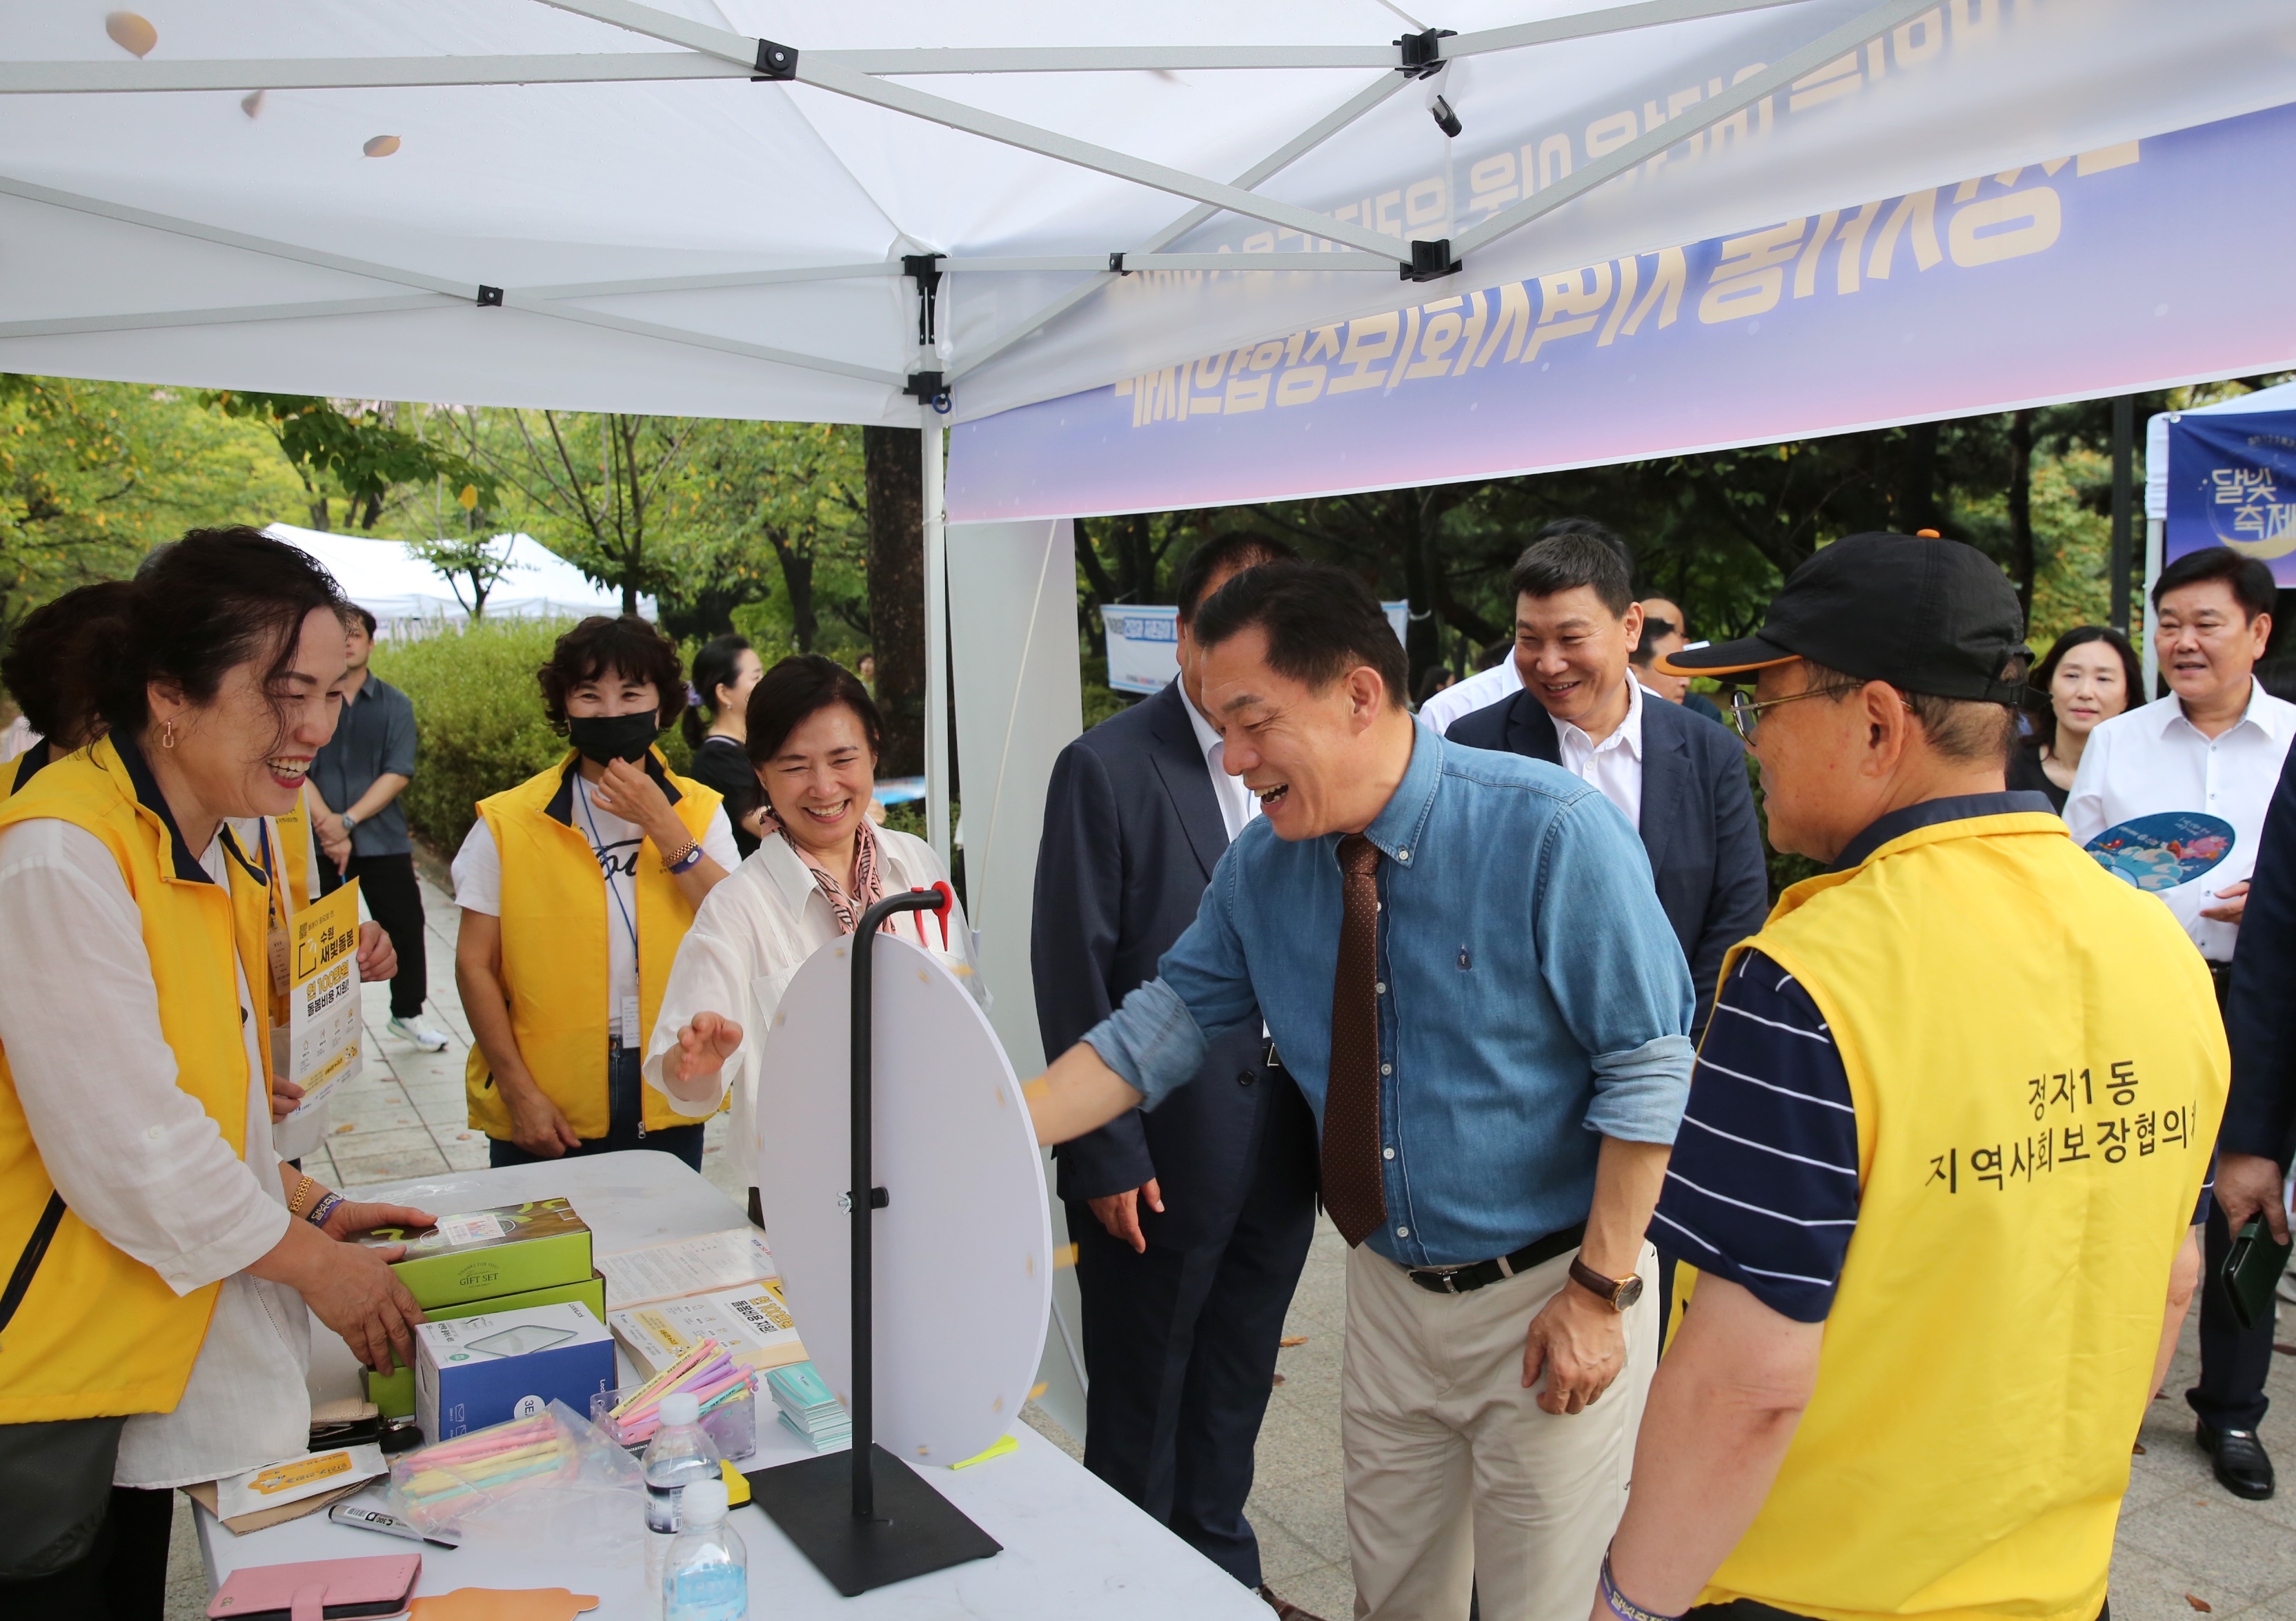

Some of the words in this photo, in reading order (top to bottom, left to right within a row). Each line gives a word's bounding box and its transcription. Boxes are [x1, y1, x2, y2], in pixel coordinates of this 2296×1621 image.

[2211, 467, 2277, 504] 달빛
[2233, 504, 2296, 540] 축제
[320, 927, 354, 965] 새빛돌봄
[321, 925, 335, 944] 수원
[306, 981, 316, 1001] 연
[317, 959, 349, 995] 100만원
[307, 988, 335, 1017] 돌봄비용
[336, 979, 349, 998] 지원!
[310, 1203, 330, 1221] 달빛
[459, 1276, 480, 1286] GIFT
[482, 1273, 499, 1282] SET
[731, 1299, 764, 1322] 돌봄비용
[753, 1322, 778, 1334] 지원!
[749, 1295, 770, 1306] 연
